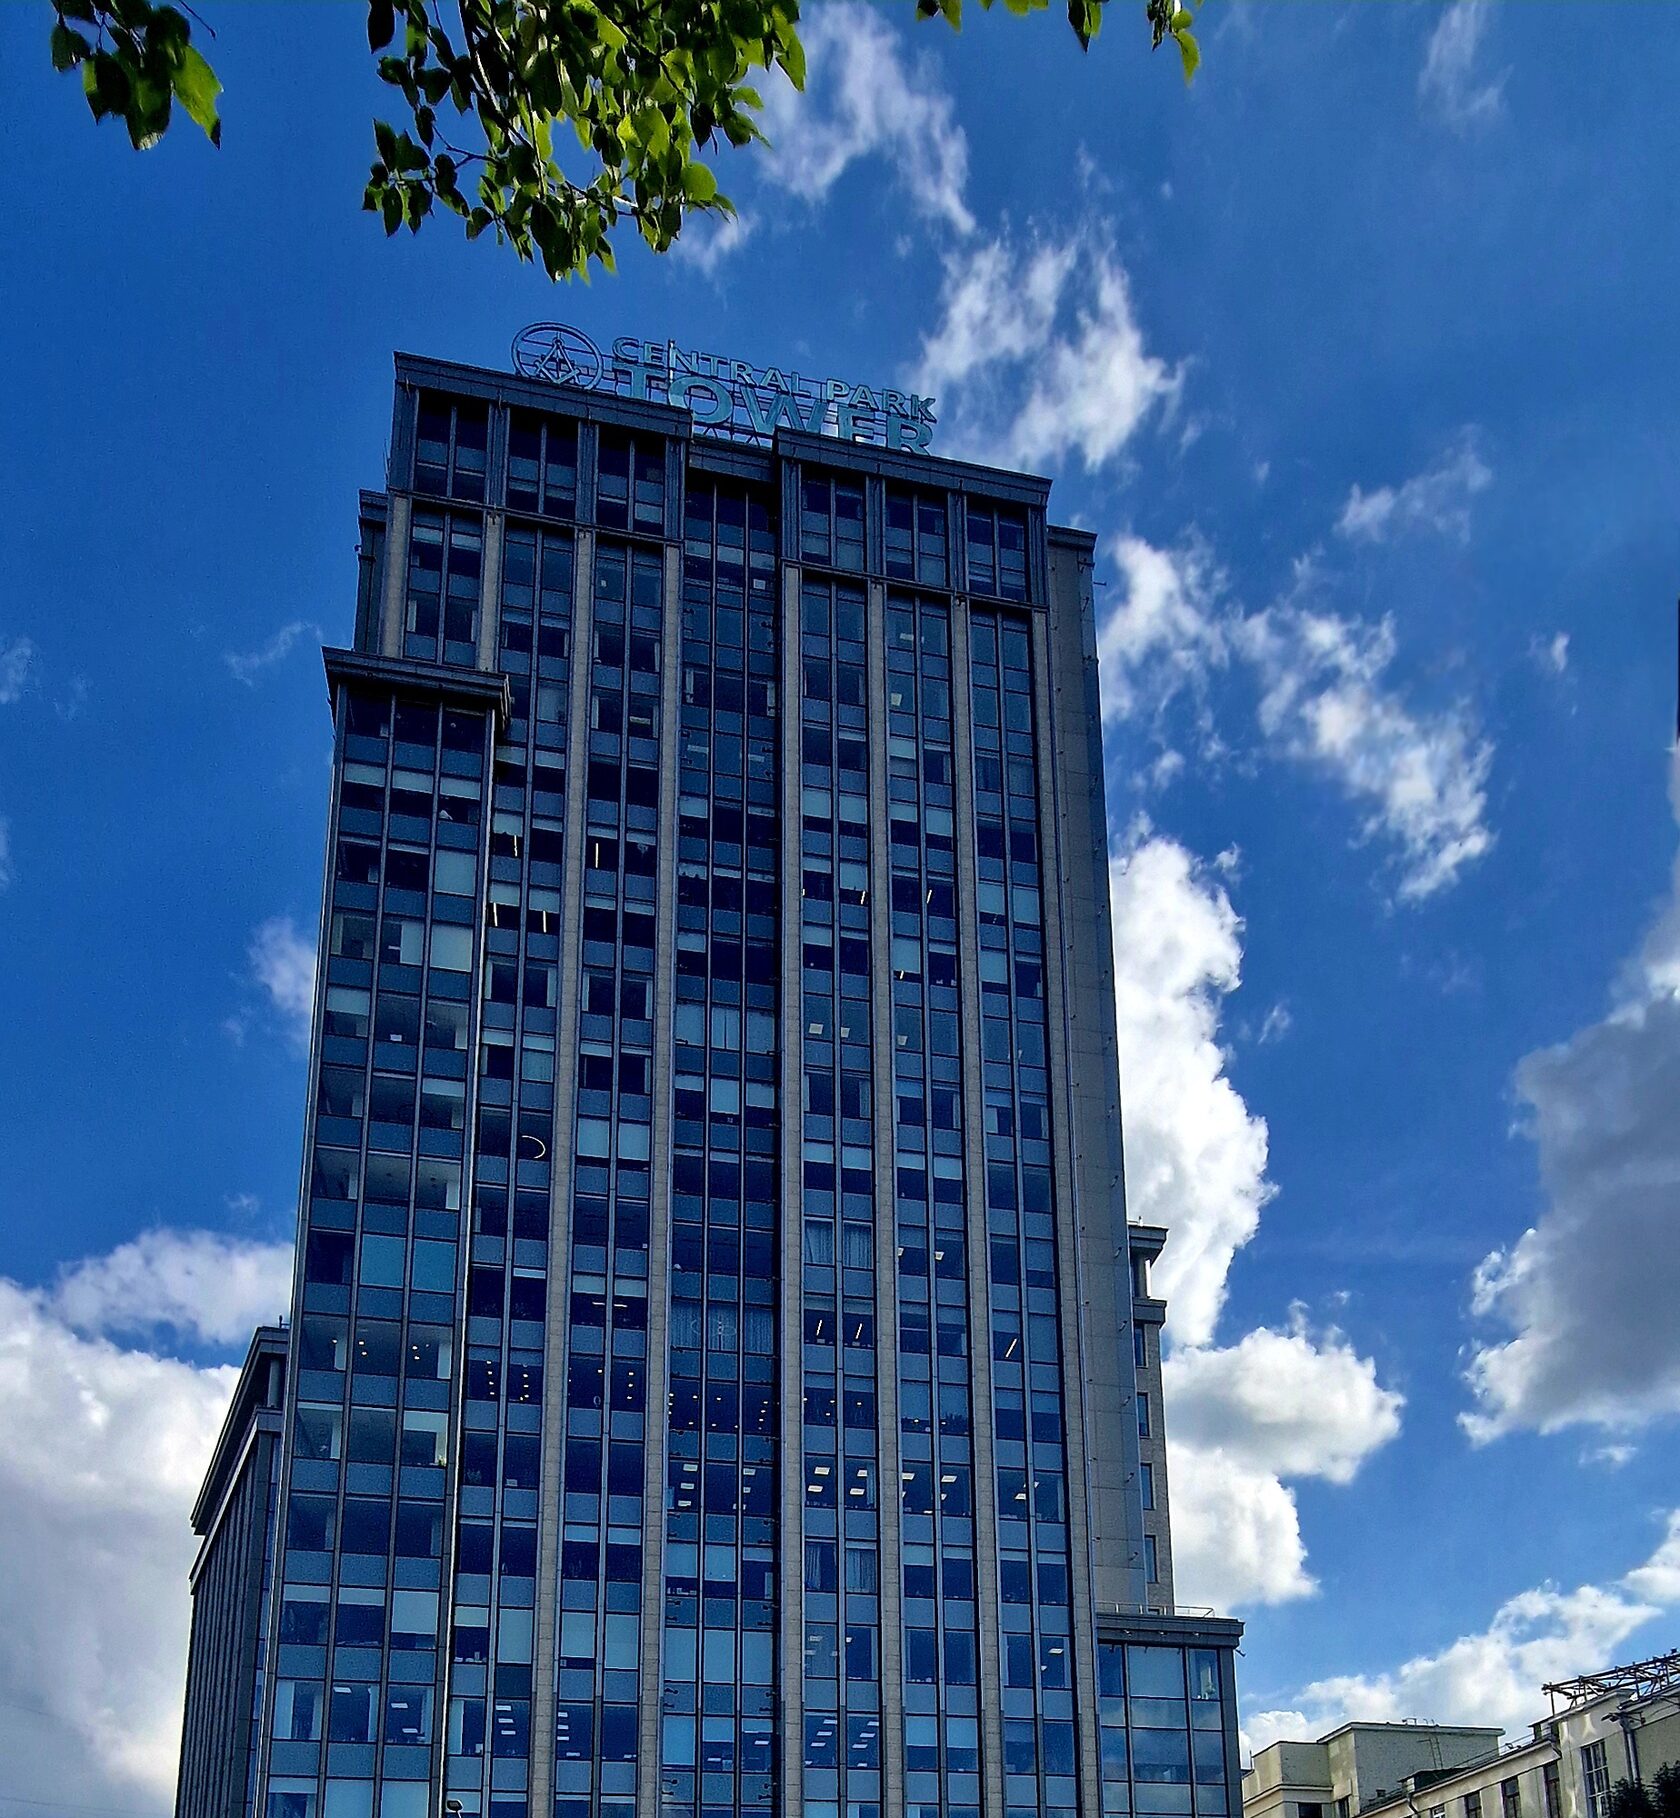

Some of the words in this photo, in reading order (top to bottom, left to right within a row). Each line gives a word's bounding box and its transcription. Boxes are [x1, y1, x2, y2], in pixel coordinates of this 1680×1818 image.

[612, 337, 811, 398] CENTRAL
[826, 378, 937, 423] PARK
[612, 362, 933, 456] TOWER
